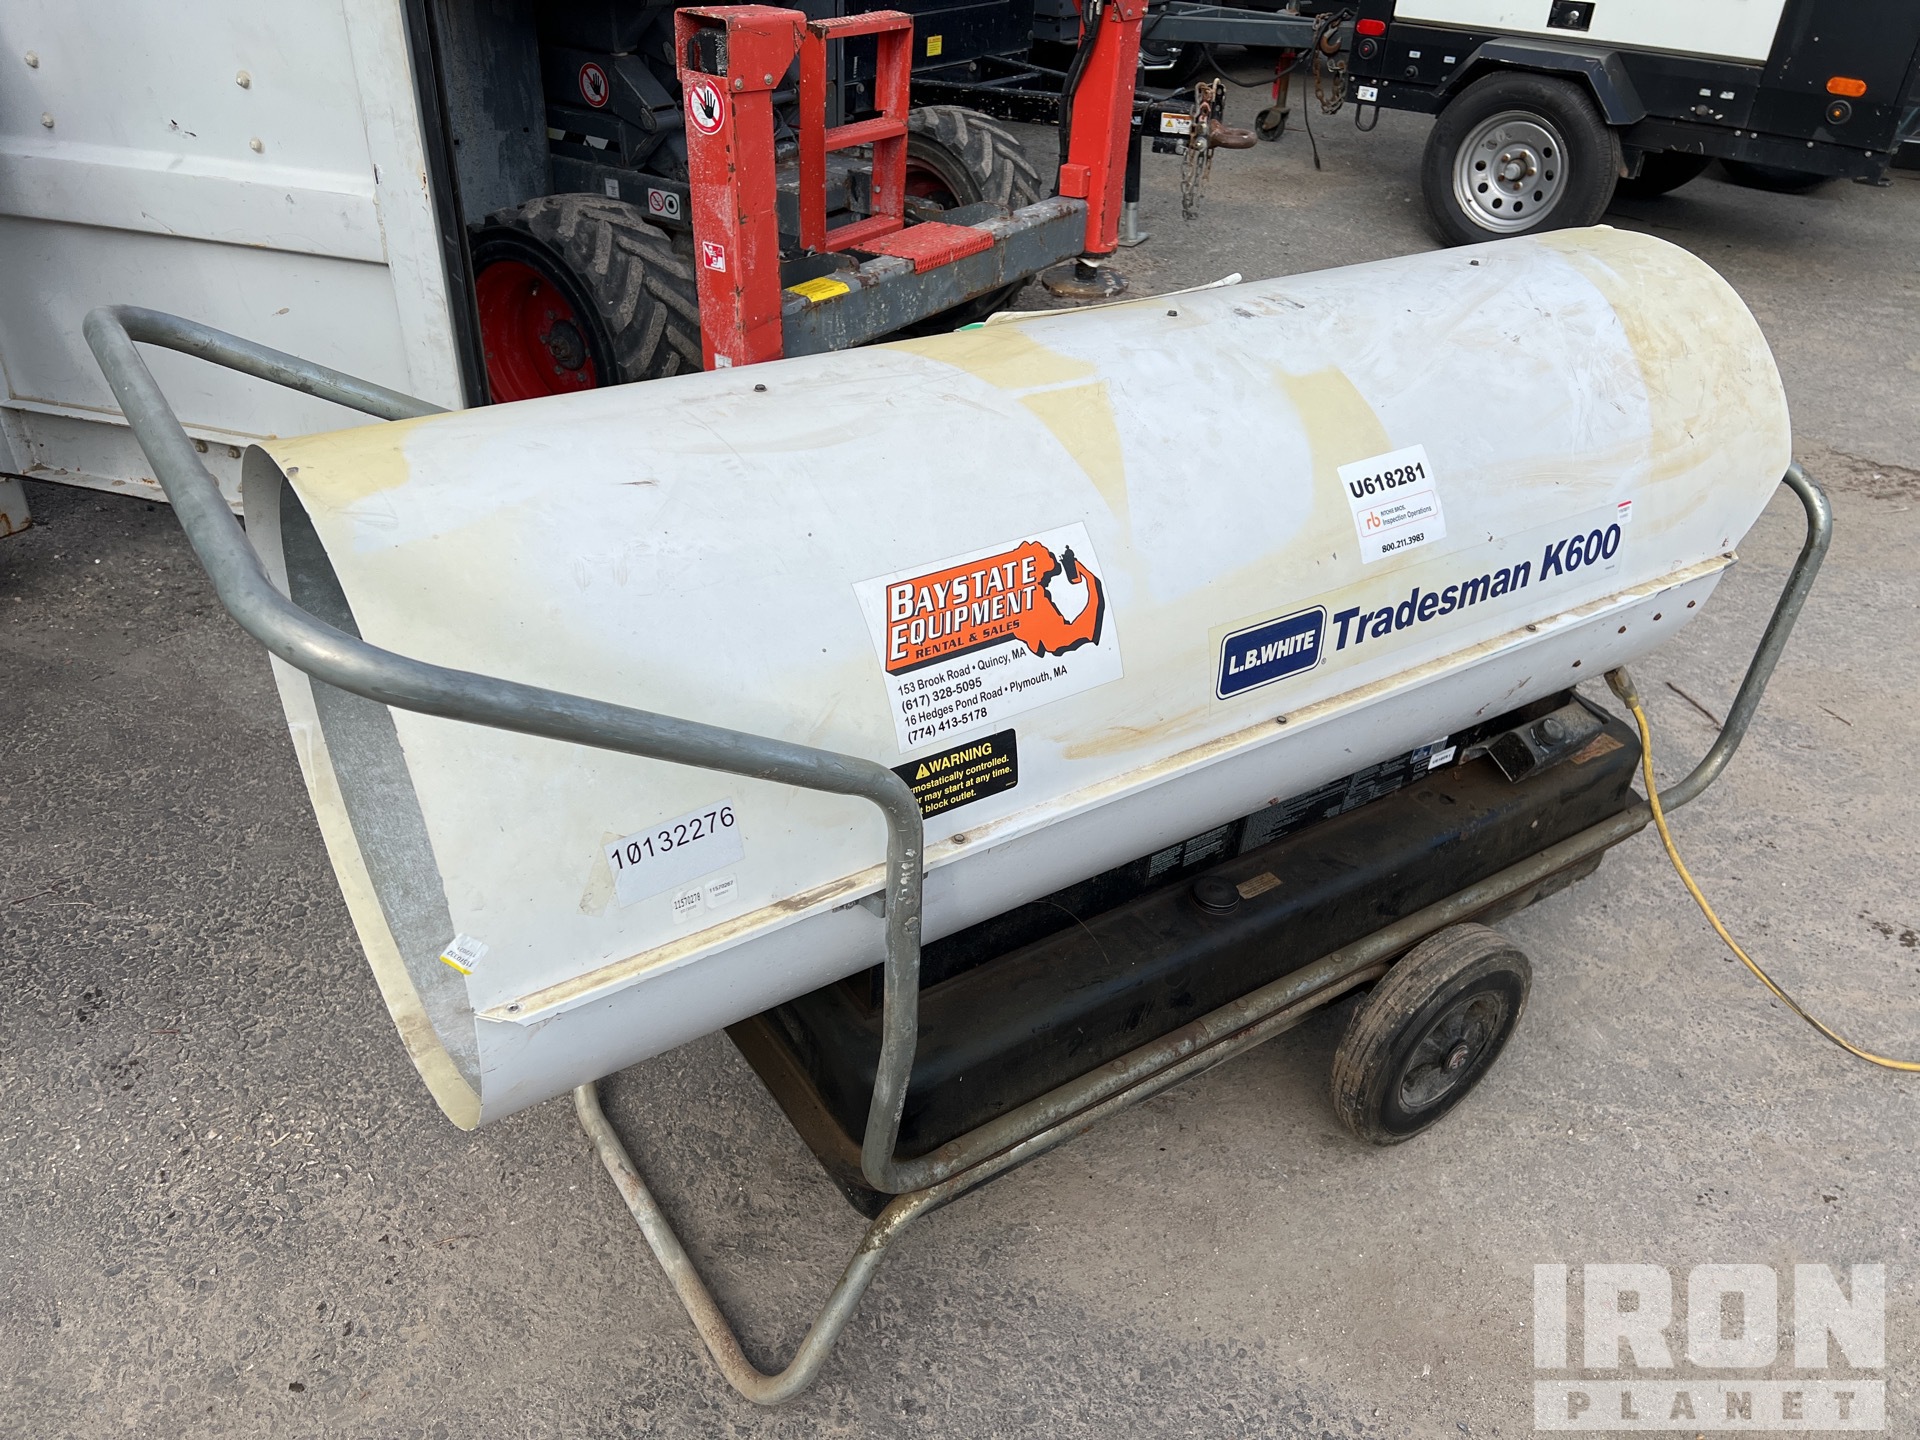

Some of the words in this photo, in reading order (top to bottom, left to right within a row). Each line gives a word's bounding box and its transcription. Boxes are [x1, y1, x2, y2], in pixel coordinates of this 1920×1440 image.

[1349, 461, 1426, 499] U618281
[1383, 513, 1407, 526] Inspection
[1407, 505, 1432, 519] Operations
[1382, 532, 1425, 553] 800.211.3983
[1332, 560, 1531, 651] Tradesman
[1539, 522, 1621, 581] K600
[915, 640, 964, 660] RENTAL
[969, 632, 978, 643] &
[983, 619, 1020, 638] SALES
[898, 682, 916, 696] 153
[917, 672, 946, 692] Brook
[947, 664, 971, 681] Road
[977, 654, 1011, 673] Quincy,
[1012, 647, 1027, 659] MA
[901, 693, 931, 714] (617)
[932, 677, 983, 702] 328-5095
[905, 715, 917, 728] 16
[918, 699, 954, 723] Hedges
[955, 692, 978, 711] Pond
[979, 685, 1004, 703] Road
[1010, 672, 1053, 694] Plymouth,
[1054, 664, 1068, 677] MA
[908, 725, 936, 745] (774)
[938, 707, 988, 733] 413-5178
[929, 743, 992, 773] WARNING
[966, 755, 1010, 776] controlled.
[924, 789, 942, 803] may
[944, 782, 964, 795] start
[966, 779, 974, 789] at
[975, 773, 991, 786] any
[992, 765, 1013, 778] time.
[925, 798, 949, 814] block
[950, 790, 977, 804] outlet.
